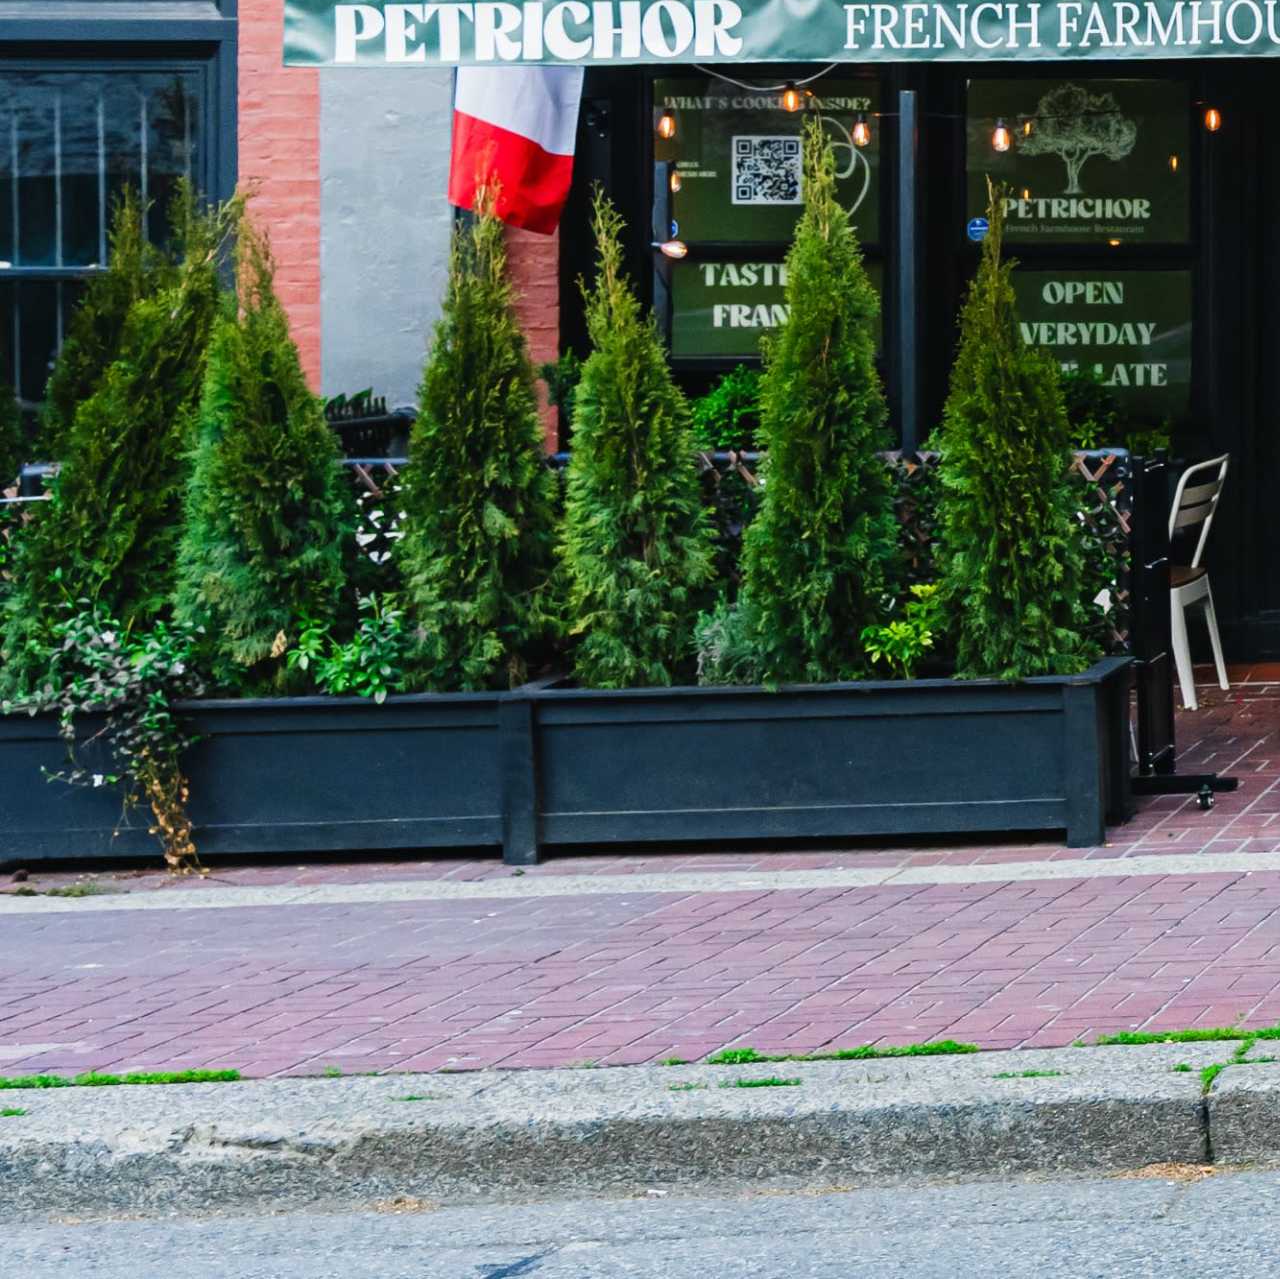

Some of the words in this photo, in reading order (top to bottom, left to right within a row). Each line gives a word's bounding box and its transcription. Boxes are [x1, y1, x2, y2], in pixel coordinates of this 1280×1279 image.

[842, 0, 1046, 52] FRENCH
[664, 96, 728, 111] WHAT'S
[1002, 197, 1151, 219] PETRICHOR
[1042, 281, 1123, 304] OPEN
[1020, 323, 1156, 345] VERYDAY
